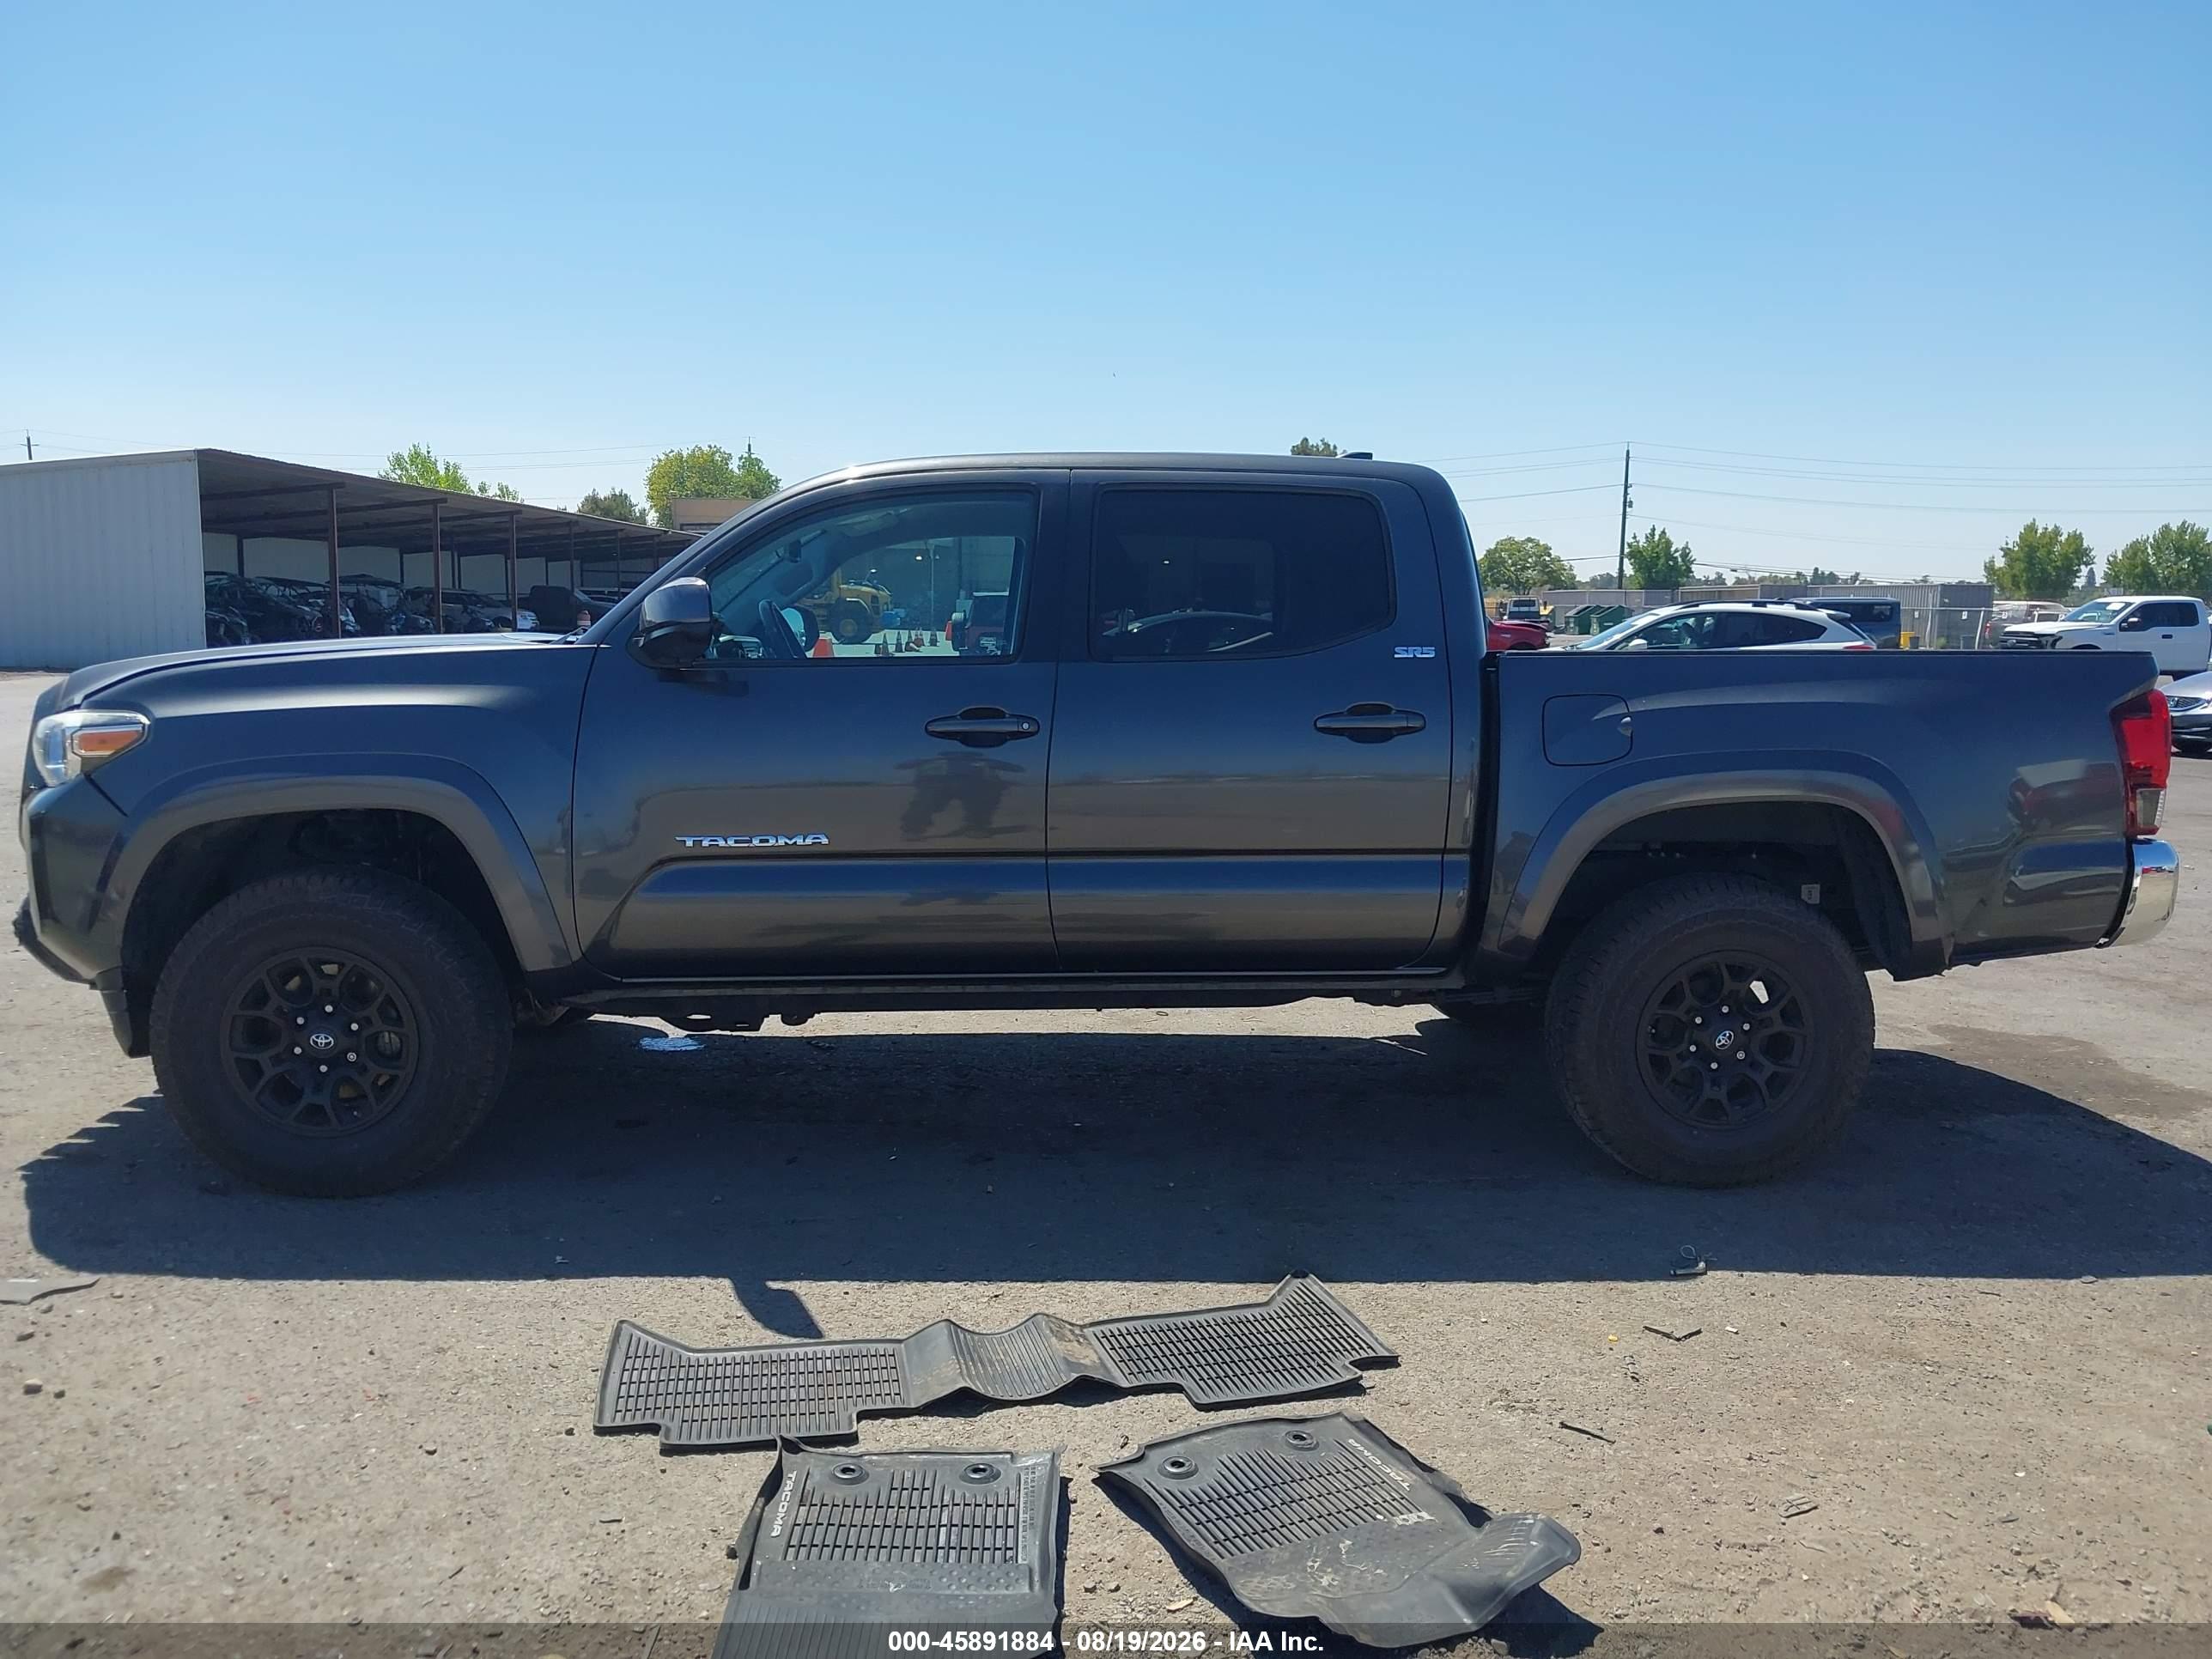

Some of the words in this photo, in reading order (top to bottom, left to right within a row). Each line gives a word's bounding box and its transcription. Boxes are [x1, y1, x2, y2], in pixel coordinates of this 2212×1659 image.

[1394, 646, 1436, 659] SR5
[675, 833, 830, 848] TACOMA
[1347, 1438, 1410, 1492] TACOMA
[770, 1470, 797, 1538] TACOMA
